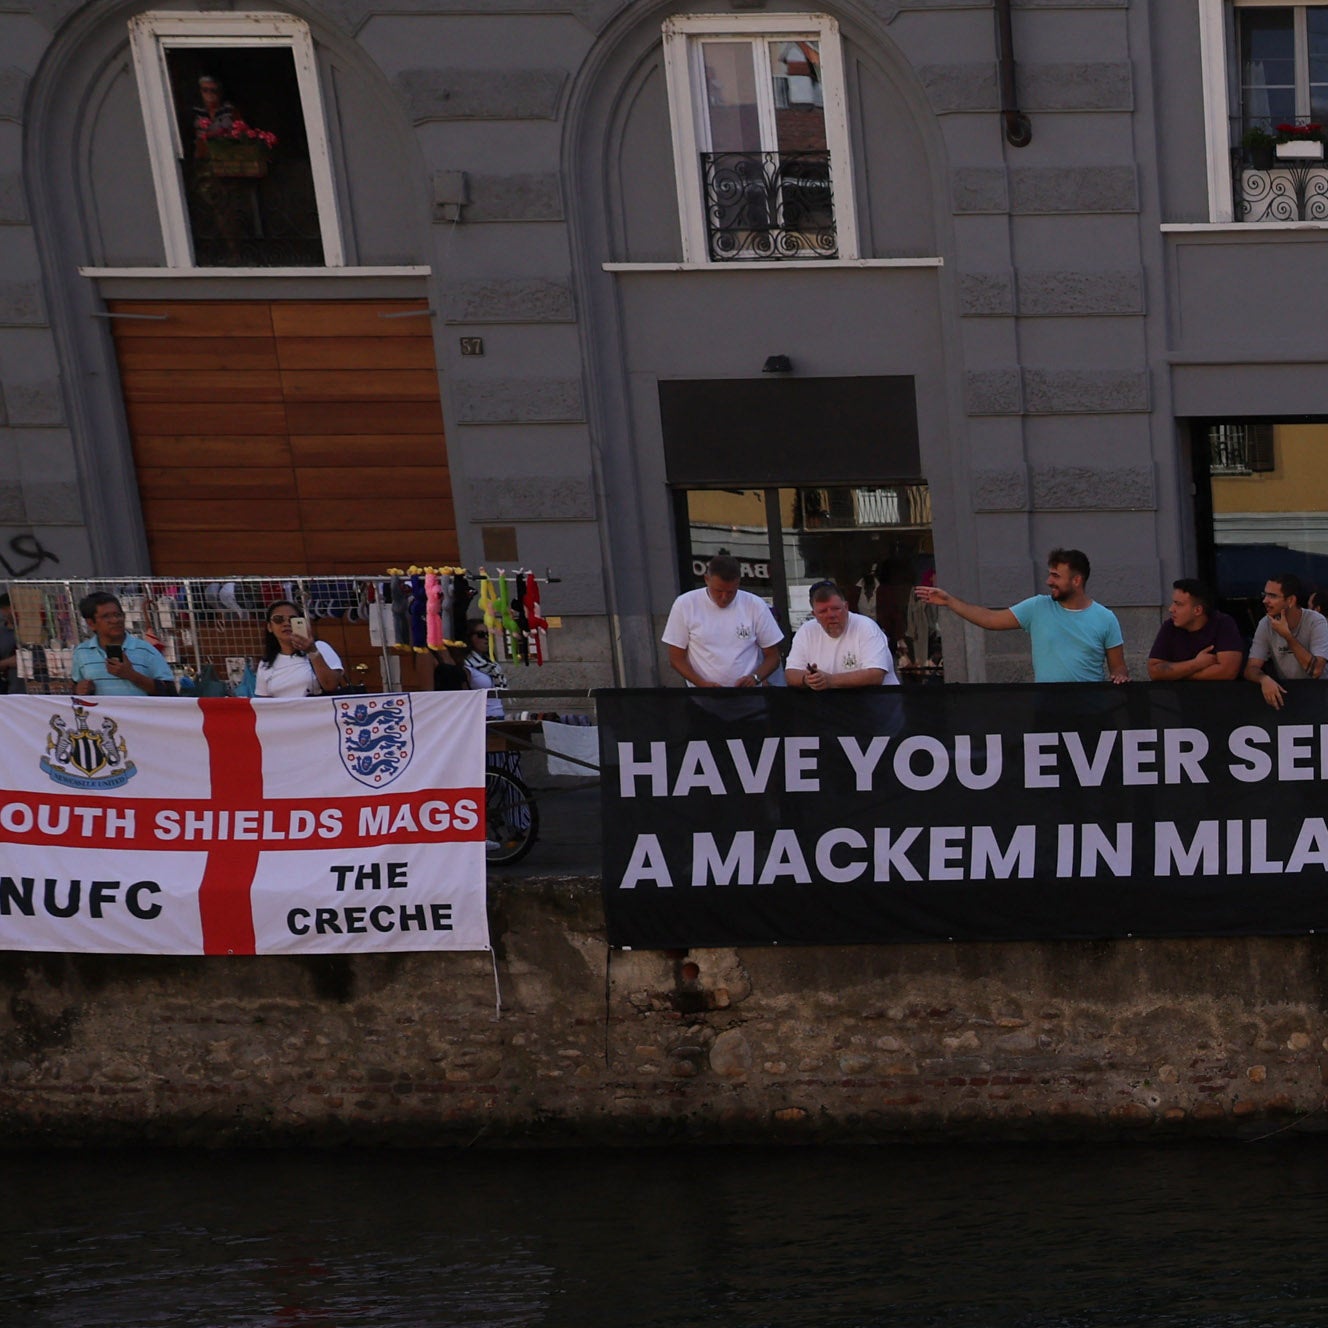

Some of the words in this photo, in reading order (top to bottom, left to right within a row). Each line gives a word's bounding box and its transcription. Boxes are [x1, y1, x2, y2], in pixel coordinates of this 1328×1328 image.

[617, 736, 820, 798] HAVE
[837, 733, 1003, 792] YOU
[1023, 727, 1210, 789] EVER
[0, 802, 136, 839] OUTH
[155, 806, 343, 841] SHIELDS
[358, 799, 478, 836] MAGS
[329, 861, 409, 892] THE
[620, 833, 673, 889] A
[691, 824, 1037, 888] MACKEM
[1055, 822, 1133, 878] IN
[0, 876, 163, 919] NUFC
[286, 903, 454, 936] CRECHE
